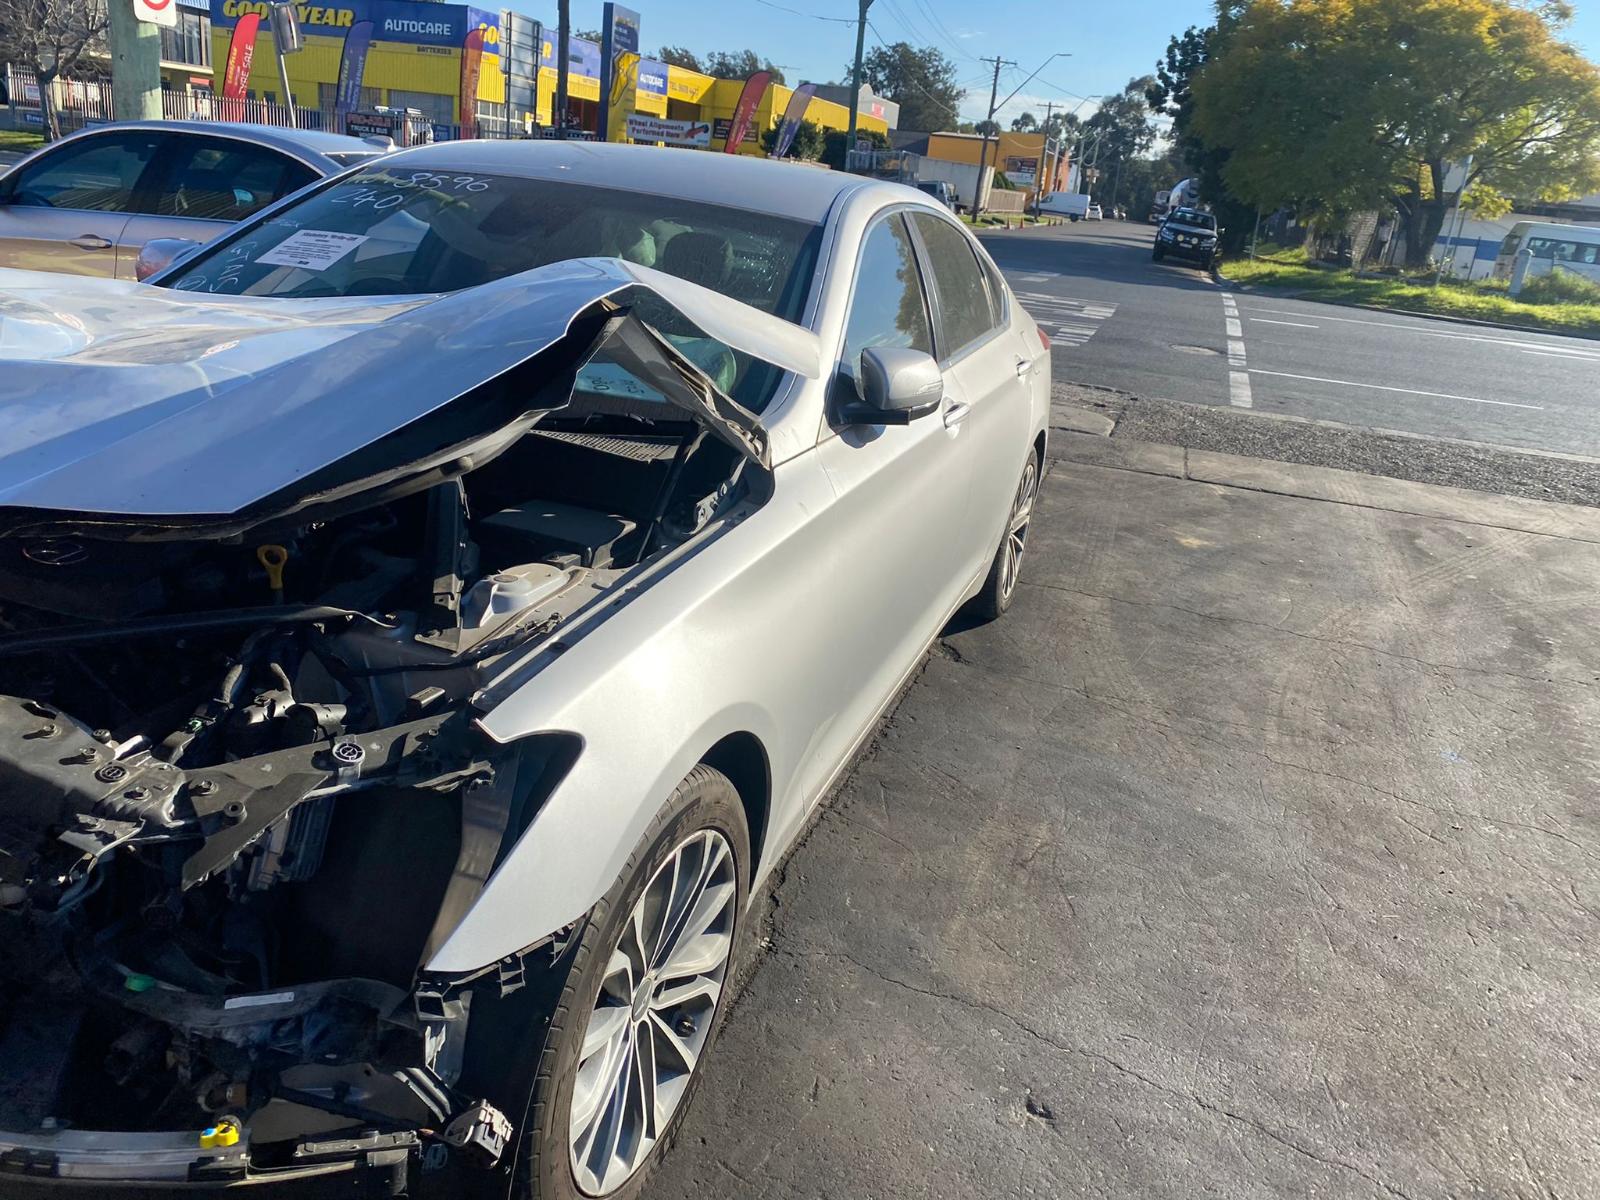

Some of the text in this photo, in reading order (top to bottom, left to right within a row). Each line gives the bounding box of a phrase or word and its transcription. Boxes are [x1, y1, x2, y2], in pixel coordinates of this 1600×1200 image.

[223, 0, 354, 27] GOOYEAR
[385, 19, 452, 35] AUTOCARE
[238, 43, 254, 97] TYRE SALE
[640, 72, 664, 88] AUTOCARE
[628, 118, 684, 132] Wheel Alignments
[631, 126, 664, 137] Performed
[393, 172, 493, 192] 8596
[329, 187, 405, 209] 240
